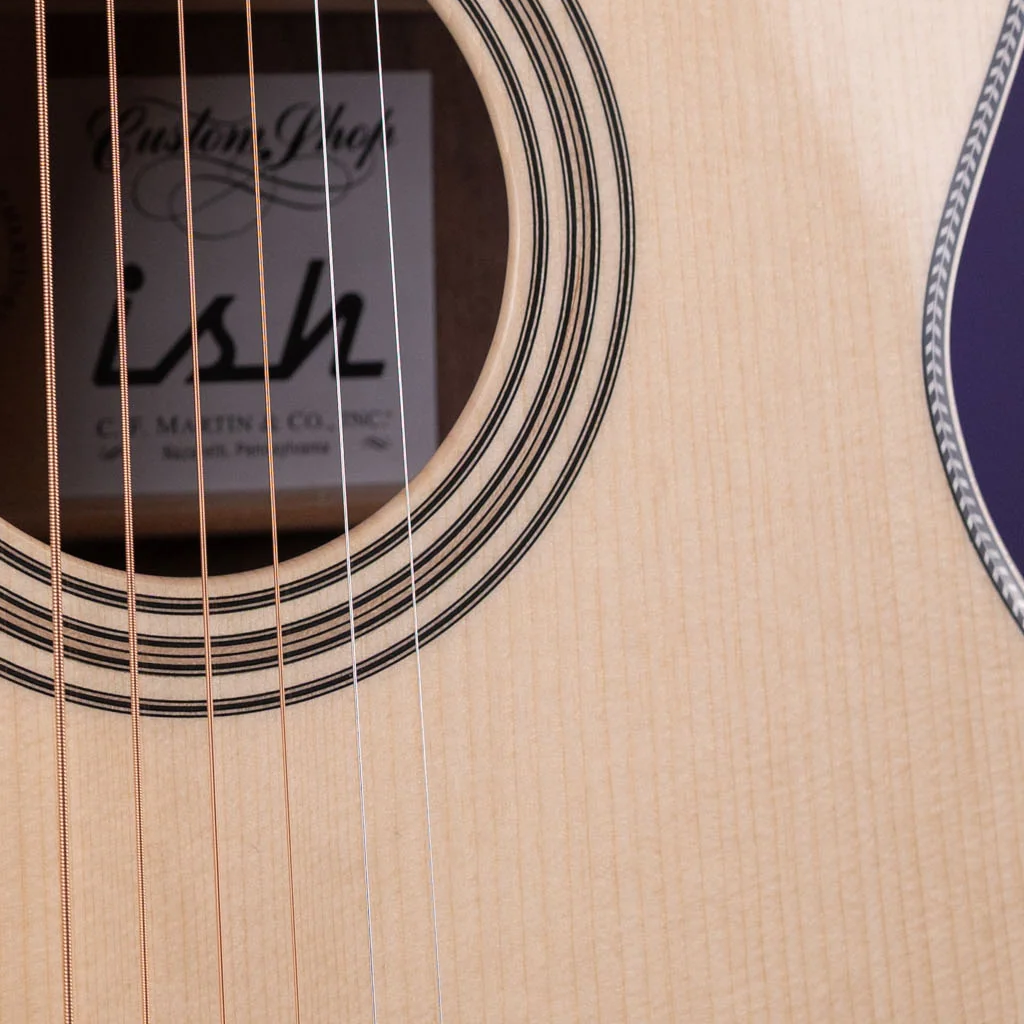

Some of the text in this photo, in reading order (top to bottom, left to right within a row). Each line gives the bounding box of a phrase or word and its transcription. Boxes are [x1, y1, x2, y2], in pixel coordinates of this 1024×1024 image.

[86, 102, 396, 173] Custom Shop
[92, 258, 386, 388] ish
[155, 411, 254, 435] MARTIN
[234, 440, 330, 458] Pensylvania
